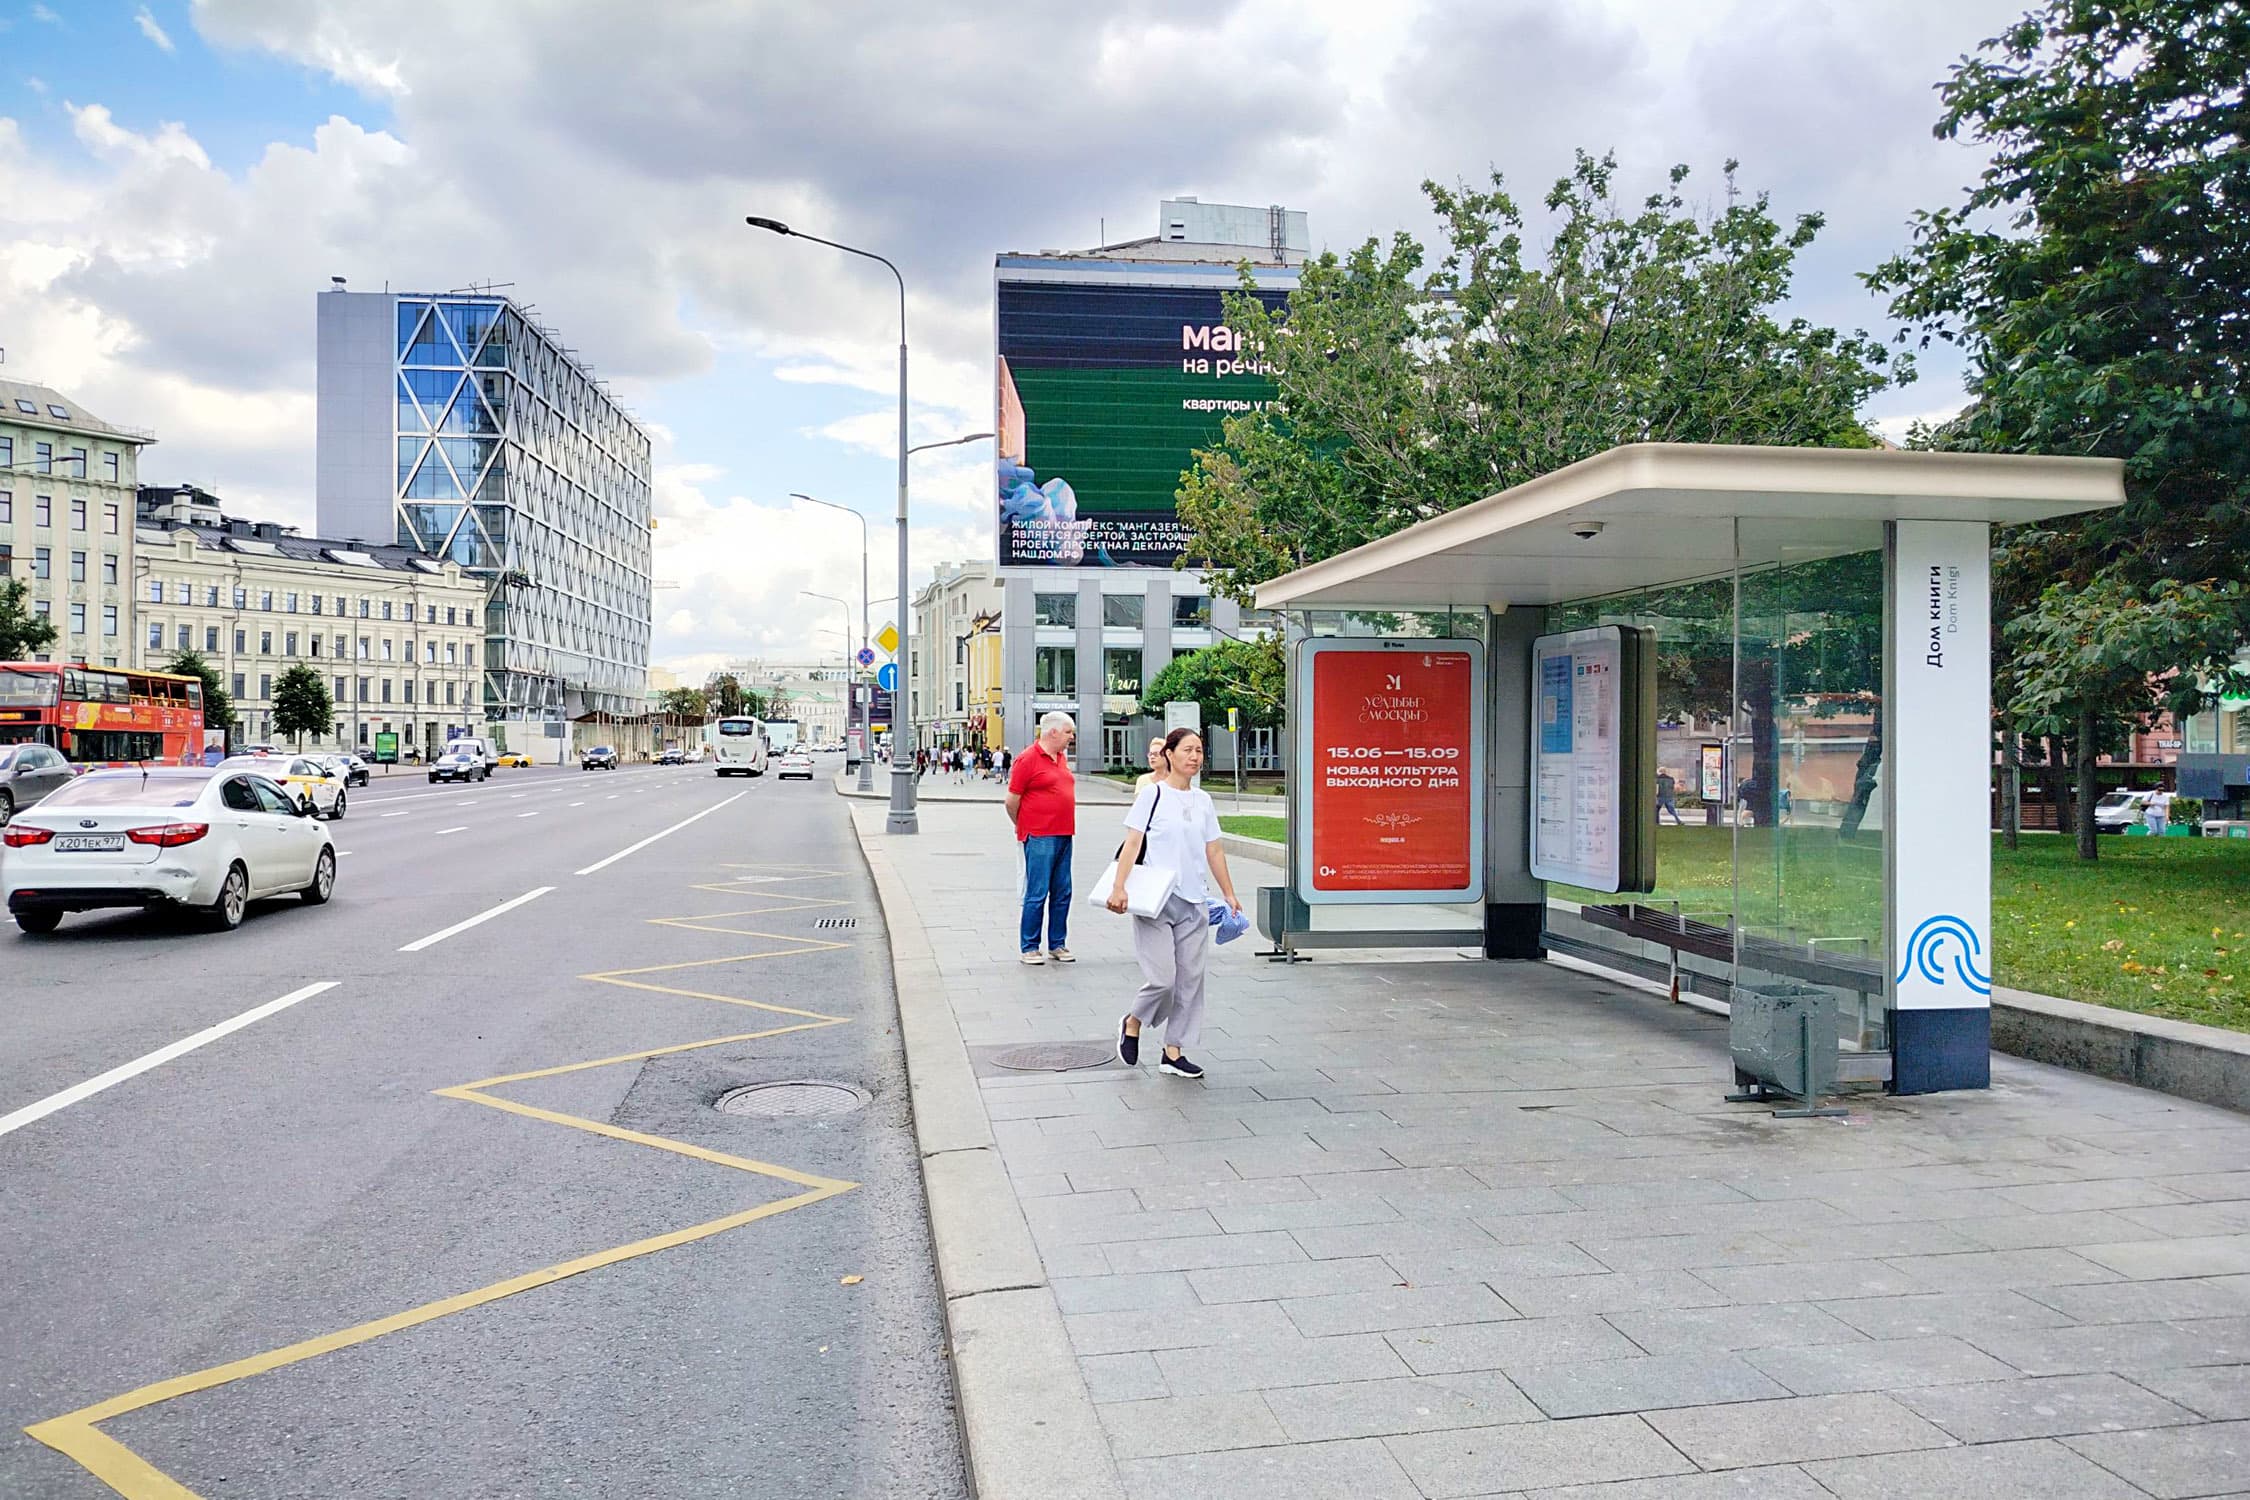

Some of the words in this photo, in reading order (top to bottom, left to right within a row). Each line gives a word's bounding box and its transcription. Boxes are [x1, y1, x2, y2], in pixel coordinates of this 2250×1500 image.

[1183, 358, 1209, 374] на
[1183, 399, 1250, 413] квартиры
[1011, 520, 1051, 529] ЖИЛОЙ
[1054, 520, 1114, 531] КОМПЛЕКС
[1012, 530, 1071, 540] ЯВЛЯЕТСЯ
[1073, 530, 1128, 541] ОФЕРТОЙ.
[1130, 531, 1198, 542] ЗАСТРОЙЩИ
[1063, 540, 1129, 551] ПРОЕКТНАЯ
[1947, 566, 1960, 599] Knigi
[1930, 566, 1941, 620] книги
[1947, 603, 1957, 633] Dom
[1927, 625, 1943, 668] Дом
[1117, 679, 1138, 690] 24/7
[1361, 694, 1426, 711] УСАДЬБЫ
[1358, 709, 1429, 723] МОСКВЫ
[1326, 766, 1379, 775] НОВАЯ
[1384, 766, 1458, 775] КУЛЬТУРА
[1326, 778, 1422, 788] ВЫХОДНОГО
[1427, 778, 1459, 788] ДНЯ
[1319, 865, 1337, 877] 0+
